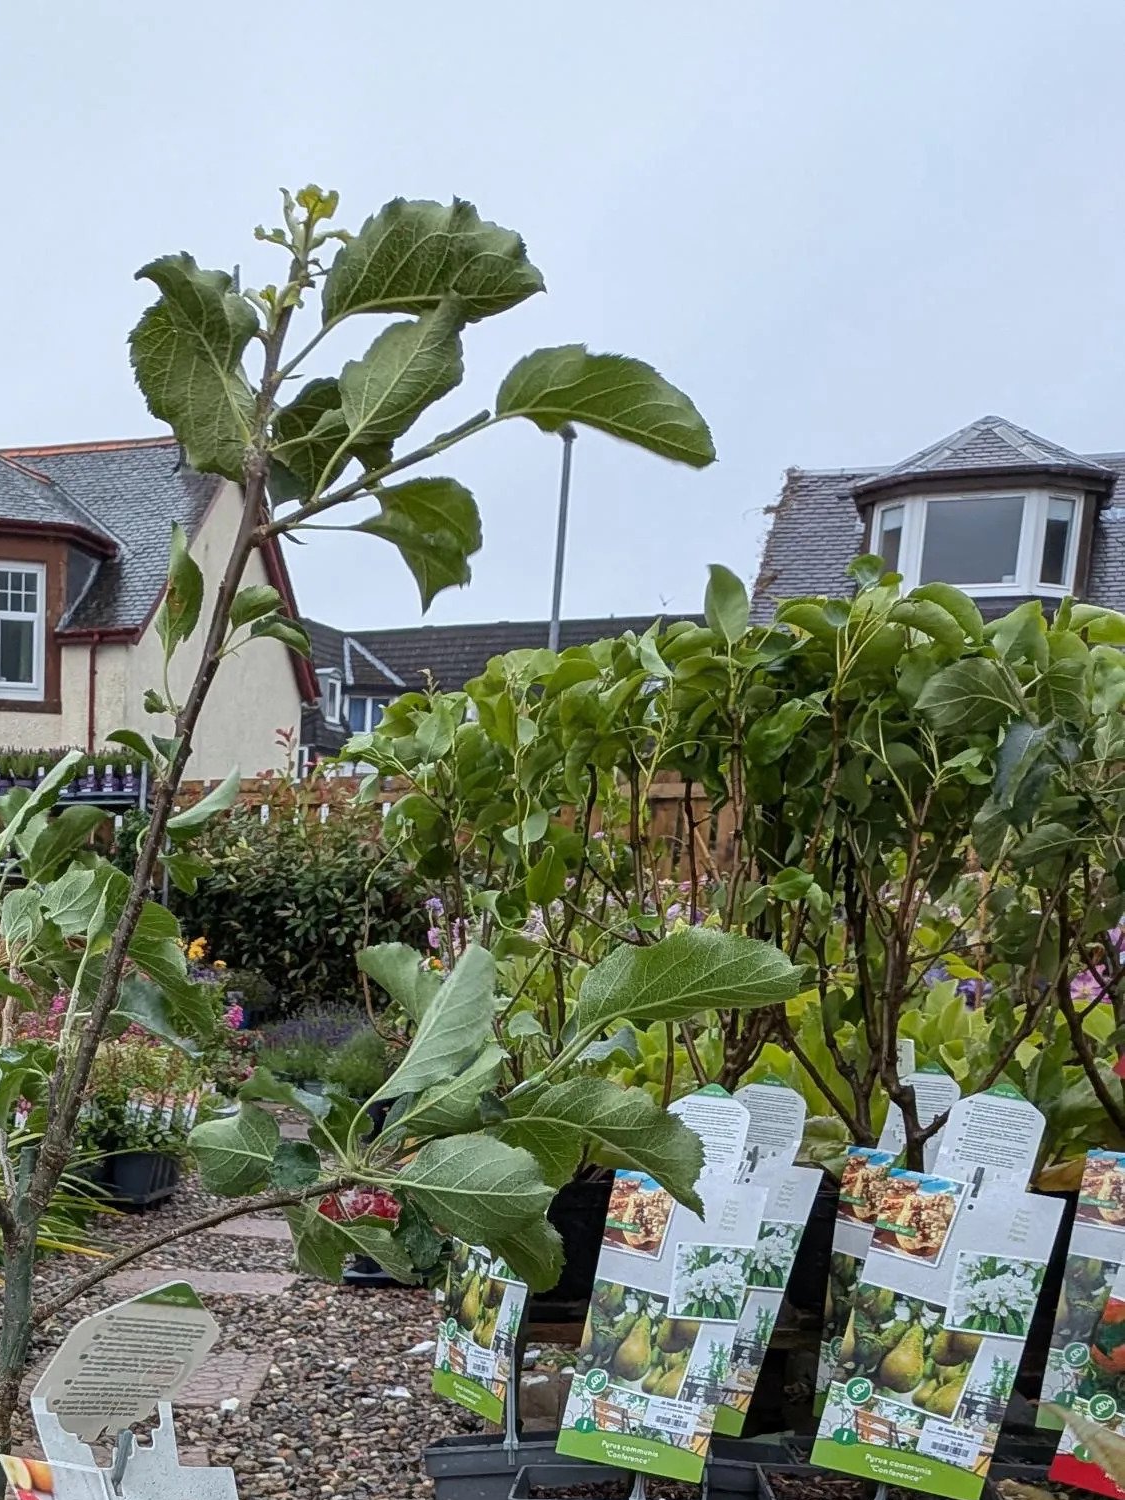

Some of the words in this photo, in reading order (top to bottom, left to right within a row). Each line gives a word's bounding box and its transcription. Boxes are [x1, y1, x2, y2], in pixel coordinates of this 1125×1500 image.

[622, 1445, 659, 1458] communis
[865, 1453, 888, 1465] Pyrus
[889, 1460, 932, 1476] communis
